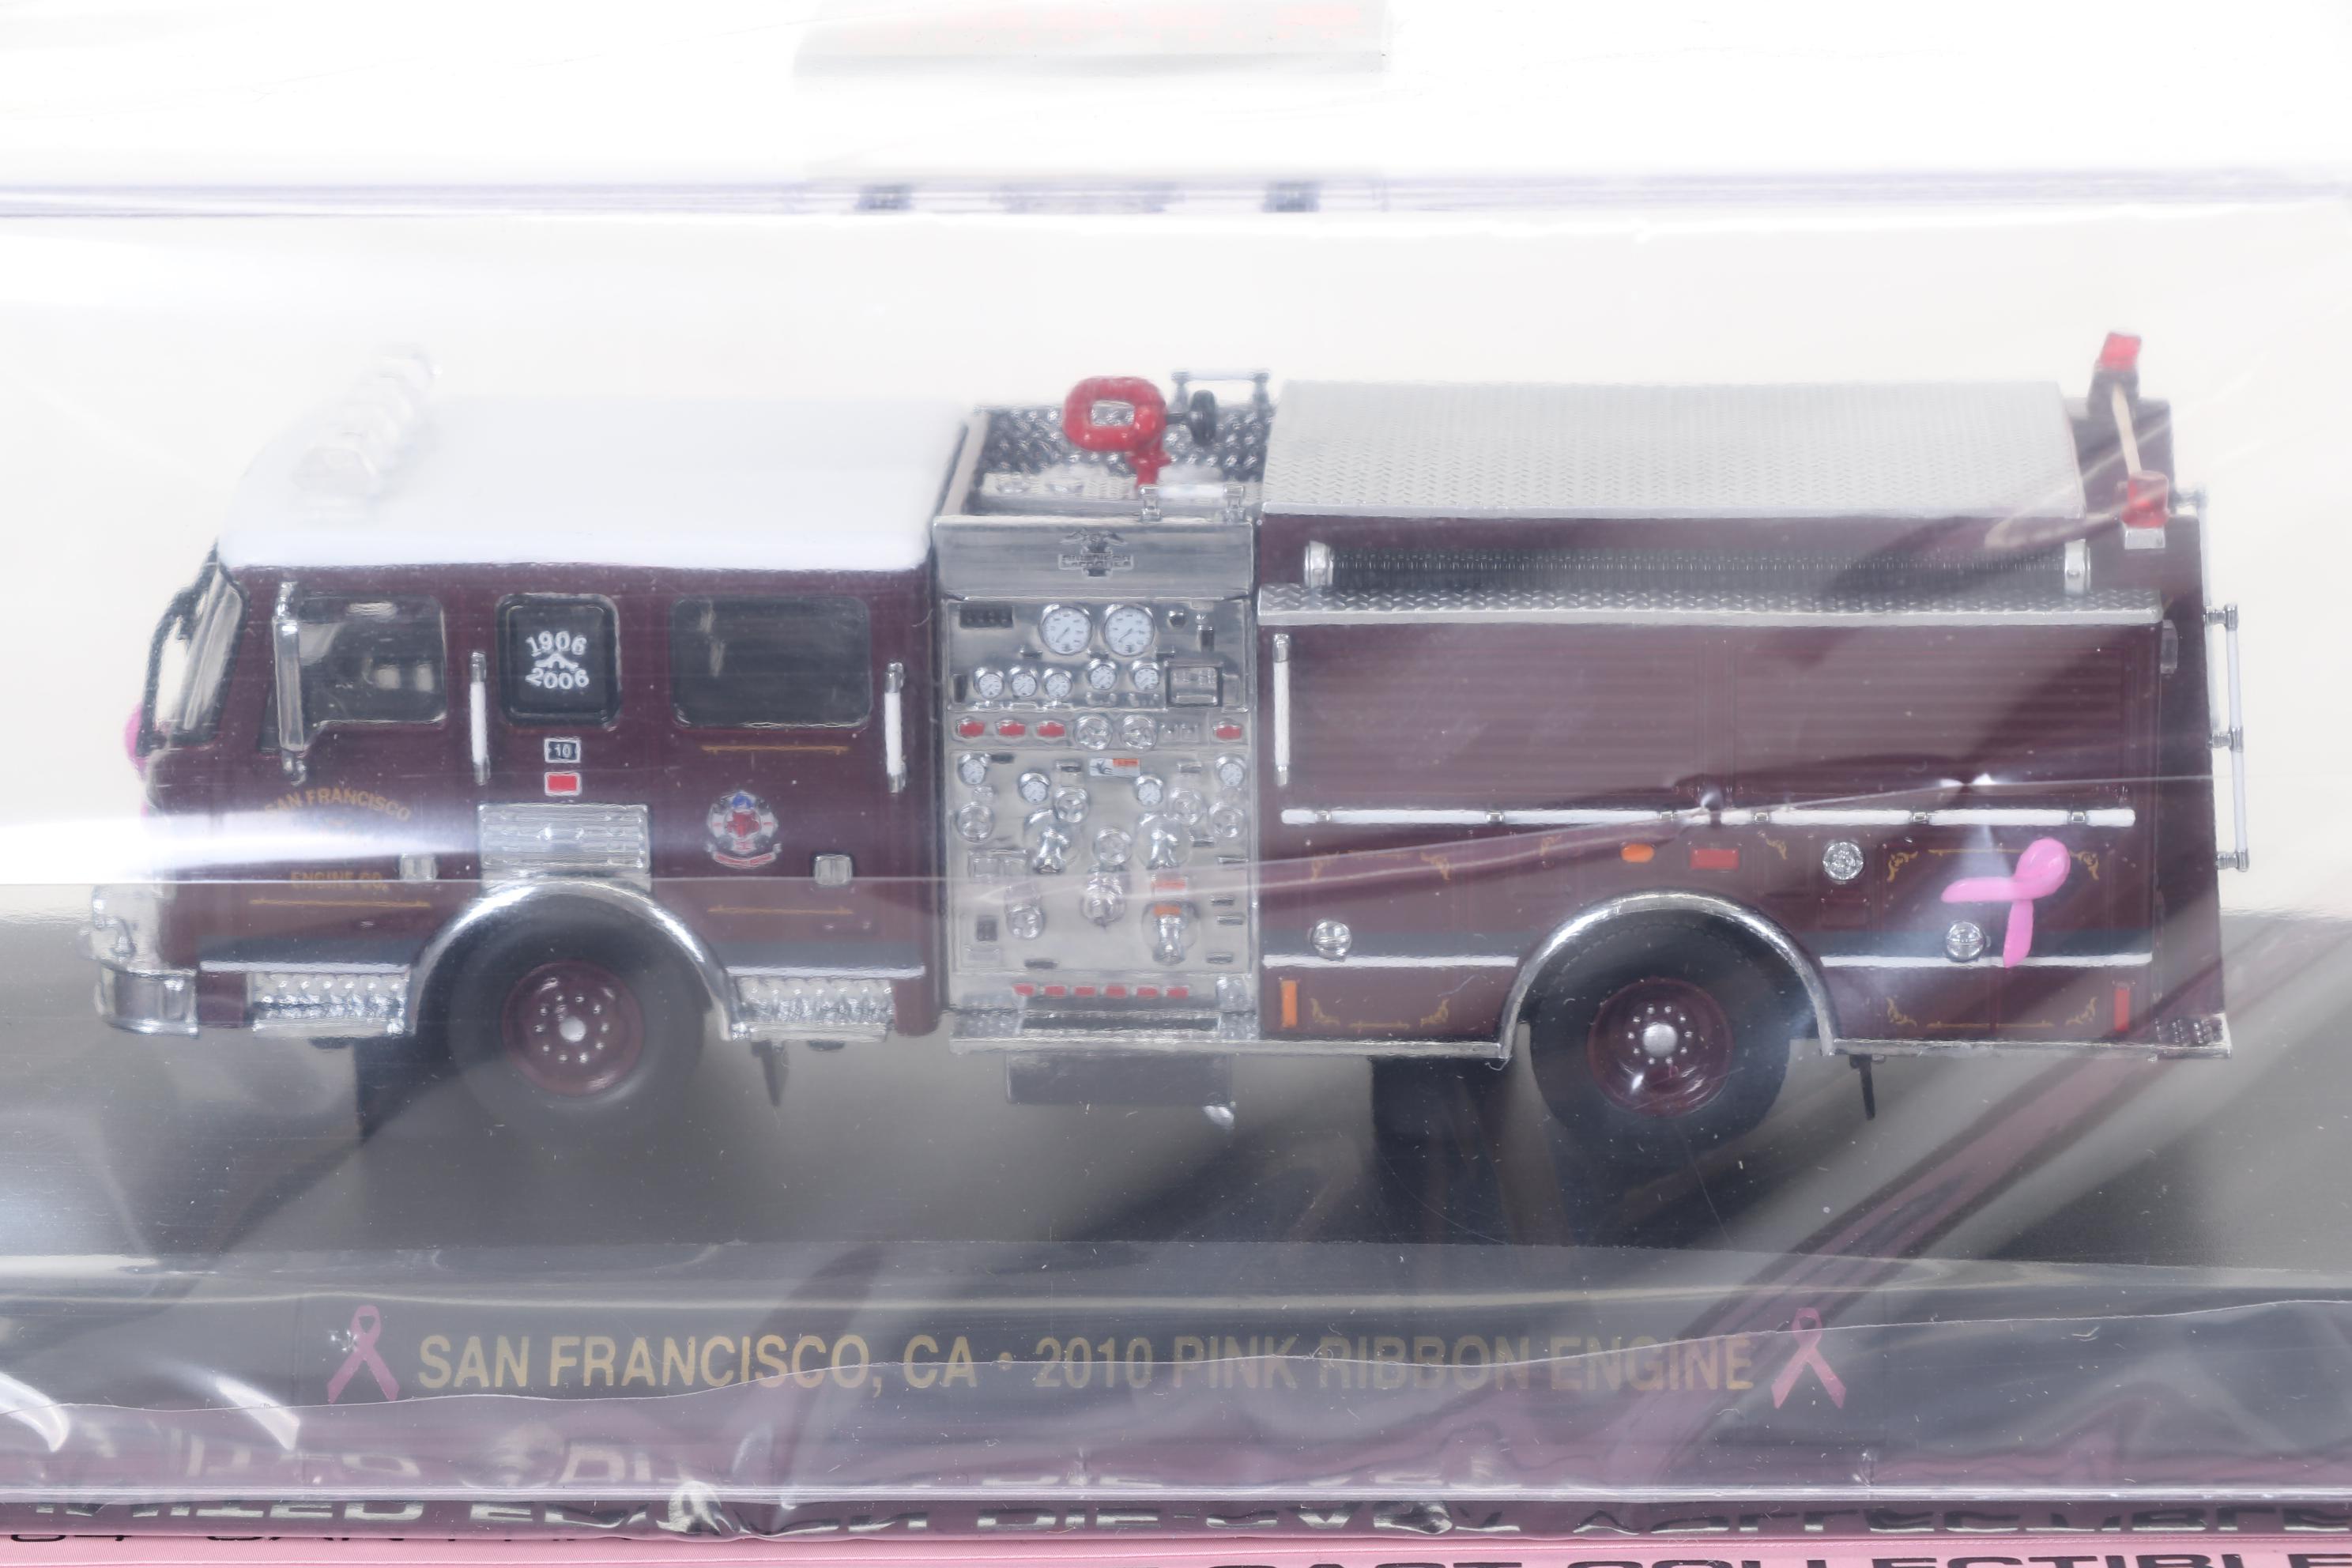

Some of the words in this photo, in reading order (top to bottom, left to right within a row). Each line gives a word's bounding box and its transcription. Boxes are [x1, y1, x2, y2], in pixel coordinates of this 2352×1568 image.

[526, 631, 587, 658] 1906
[525, 667, 590, 690] 2006
[553, 743, 572, 760] 10
[265, 792, 303, 815] SAN
[305, 786, 412, 823] FRANCISCO
[418, 1334, 530, 1389] SAN
[549, 1334, 884, 1396] FRANCISCO,
[903, 1334, 977, 1388] CA
[1034, 1336, 1154, 1389] 2010
[1173, 1336, 1298, 1389] PINK
[1318, 1336, 1530, 1390] RIBBON
[1551, 1336, 1755, 1391] ENGINE
